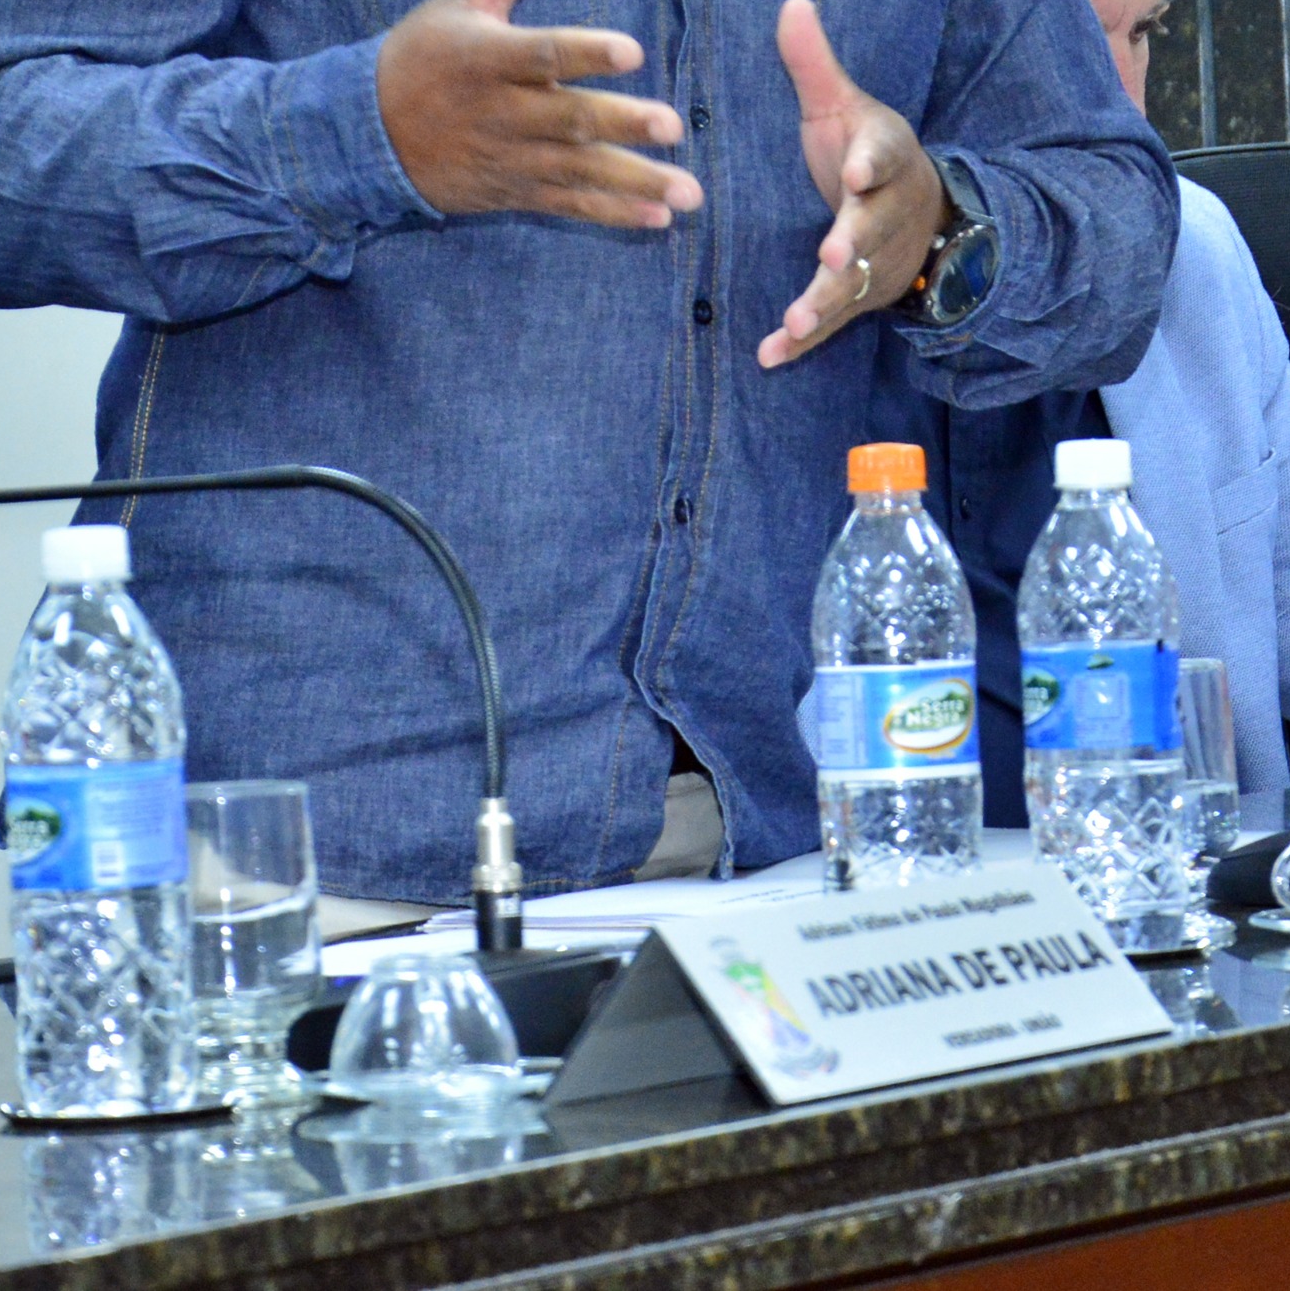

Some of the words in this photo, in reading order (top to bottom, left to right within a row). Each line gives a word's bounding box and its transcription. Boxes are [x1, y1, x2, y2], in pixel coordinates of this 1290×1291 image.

[920, 697, 964, 711] Serra
[906, 710, 960, 728] Negra
[799, 921, 853, 942] Adriana
[902, 908, 922, 924] de
[920, 901, 963, 919] Paula
[805, 956, 963, 1018] ADRIANA
[950, 948, 1009, 990] DE
[999, 930, 1113, 982] PAULA
